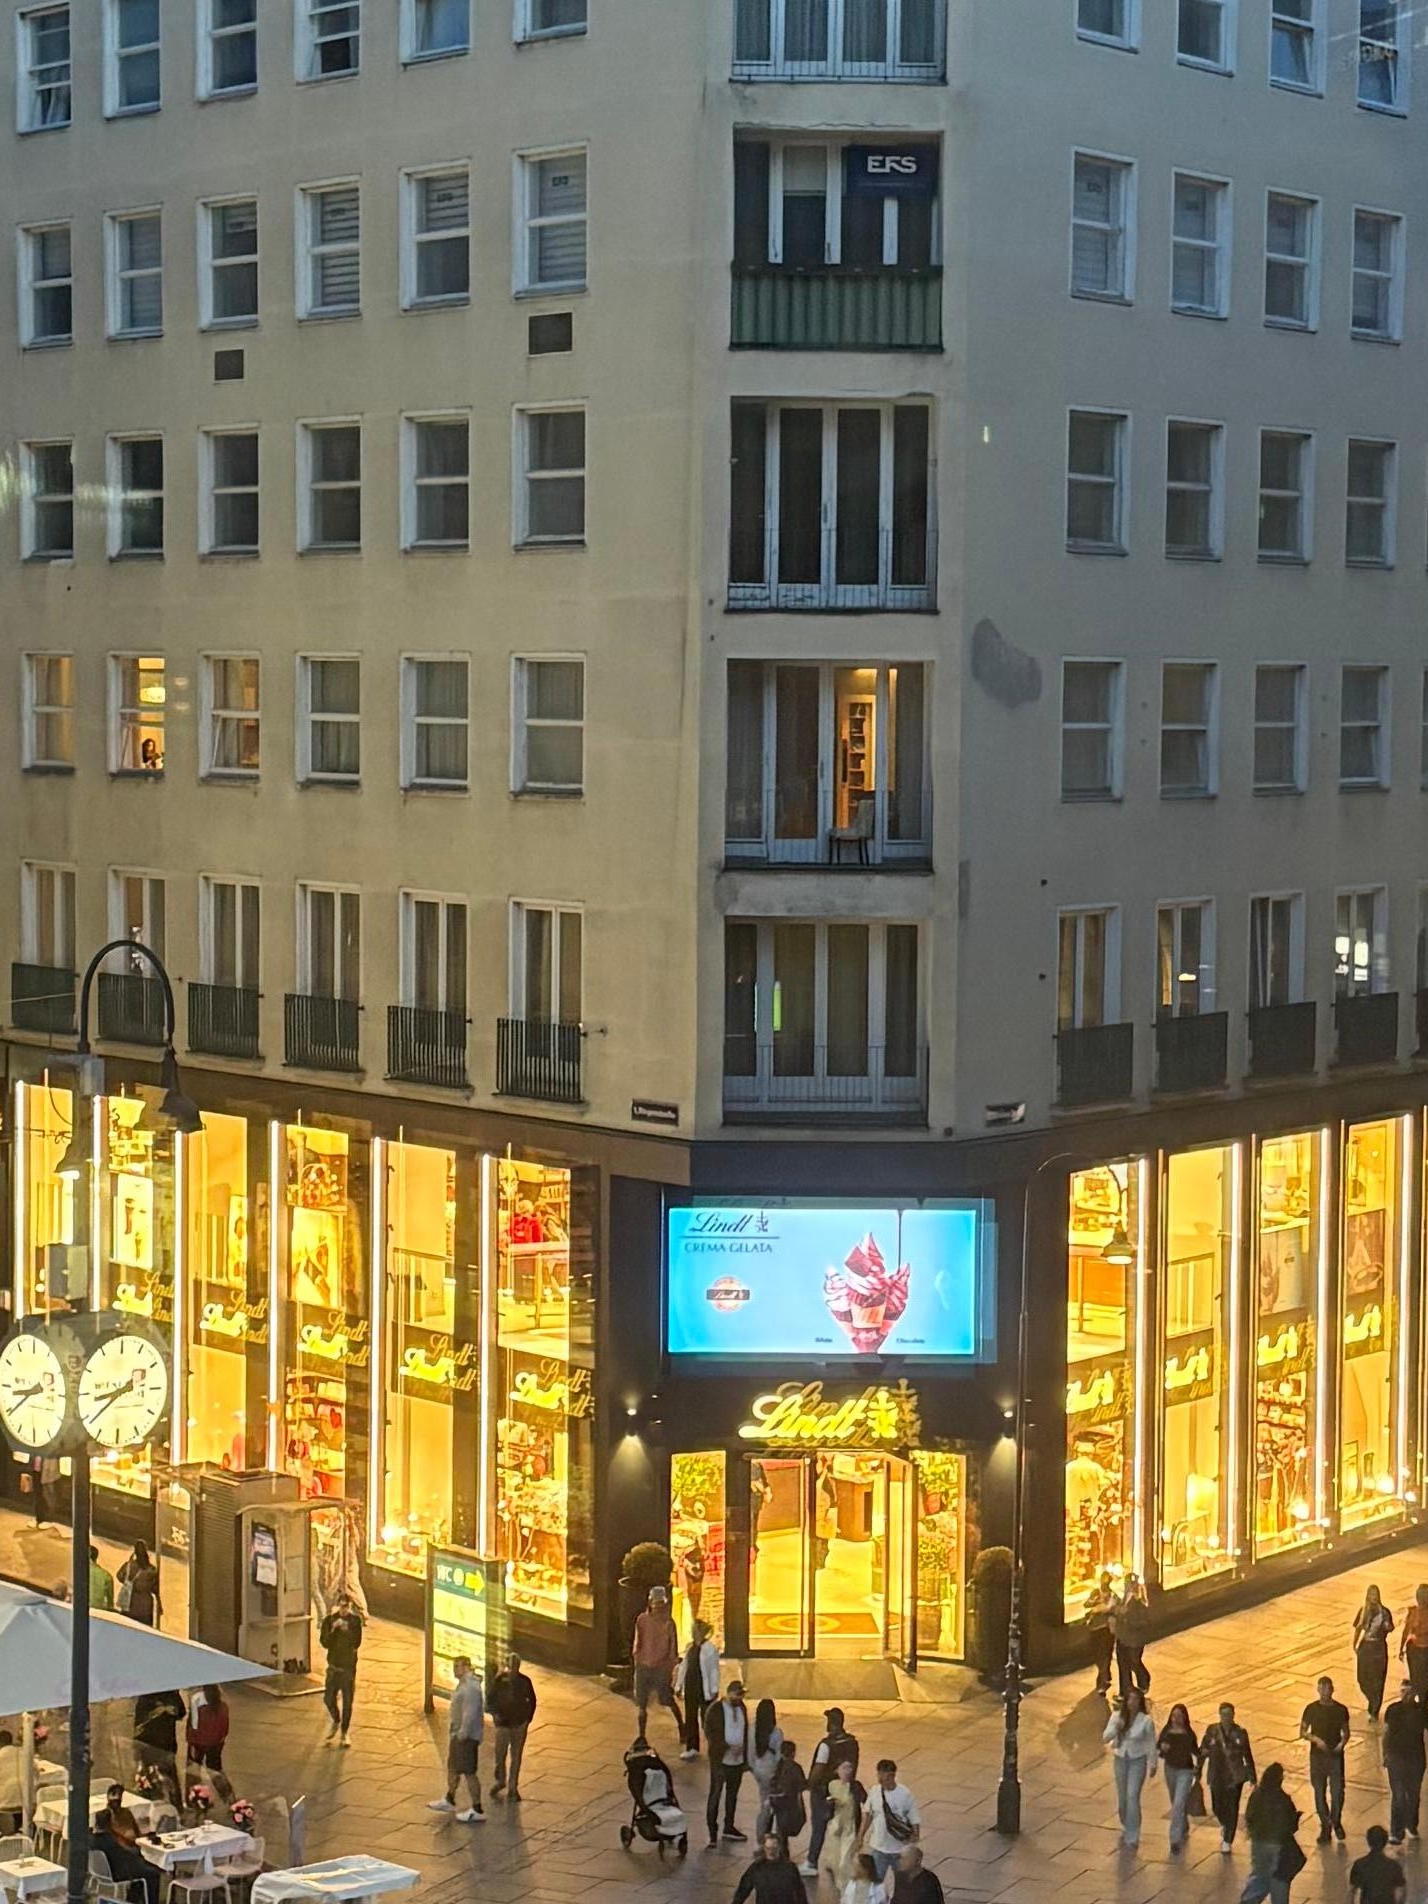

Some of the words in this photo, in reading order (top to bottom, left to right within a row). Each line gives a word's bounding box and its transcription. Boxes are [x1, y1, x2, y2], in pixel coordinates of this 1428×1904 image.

[688, 1212, 745, 1234] Lindt
[684, 1243, 726, 1253] CREMA
[729, 1243, 773, 1254] GELATA
[738, 1393, 869, 1439] Lindt
